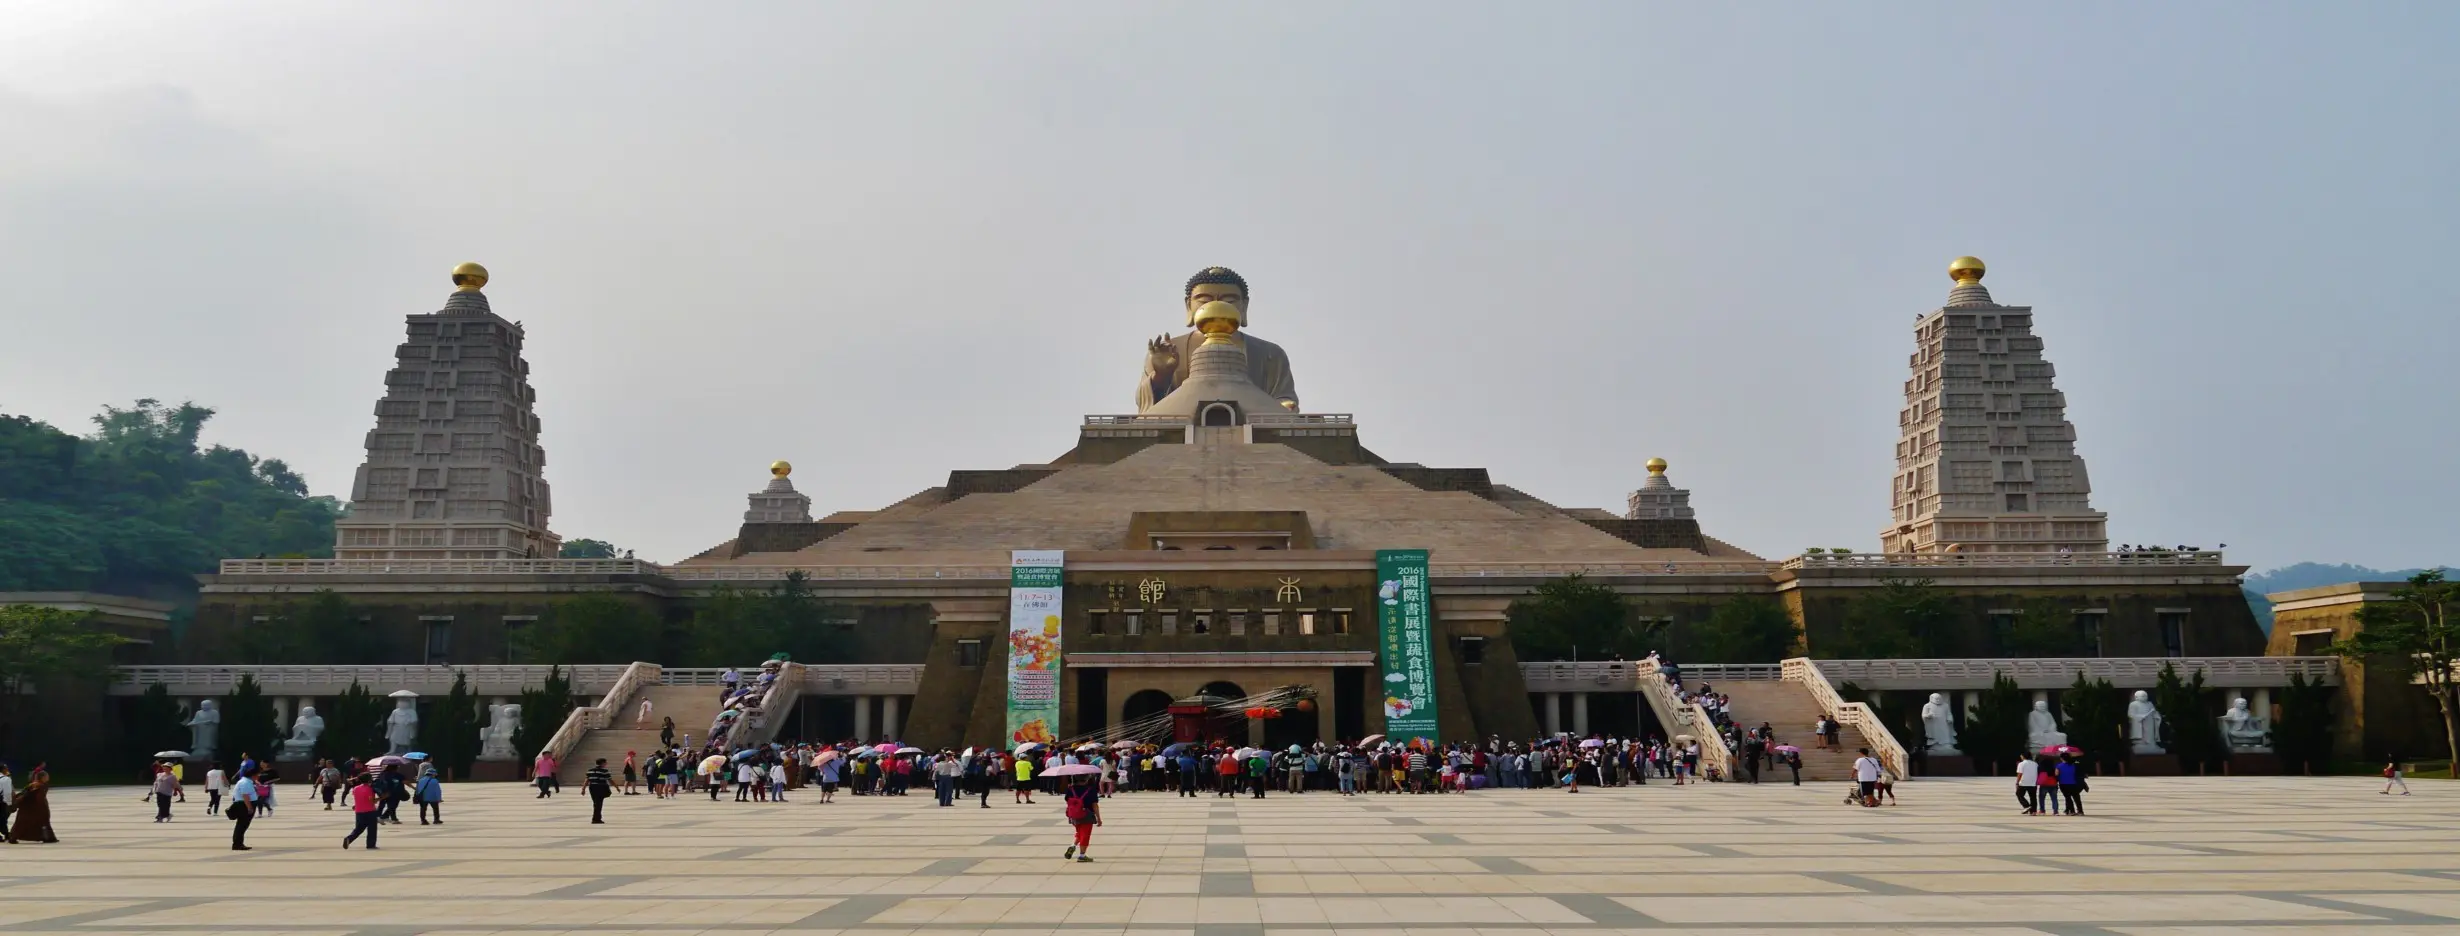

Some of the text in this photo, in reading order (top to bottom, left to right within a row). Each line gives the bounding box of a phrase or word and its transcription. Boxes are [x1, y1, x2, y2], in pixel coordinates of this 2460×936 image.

[1398, 567, 1420, 575] 2016
[1402, 575, 1427, 710] 國際書展暨蔬食博覽會
